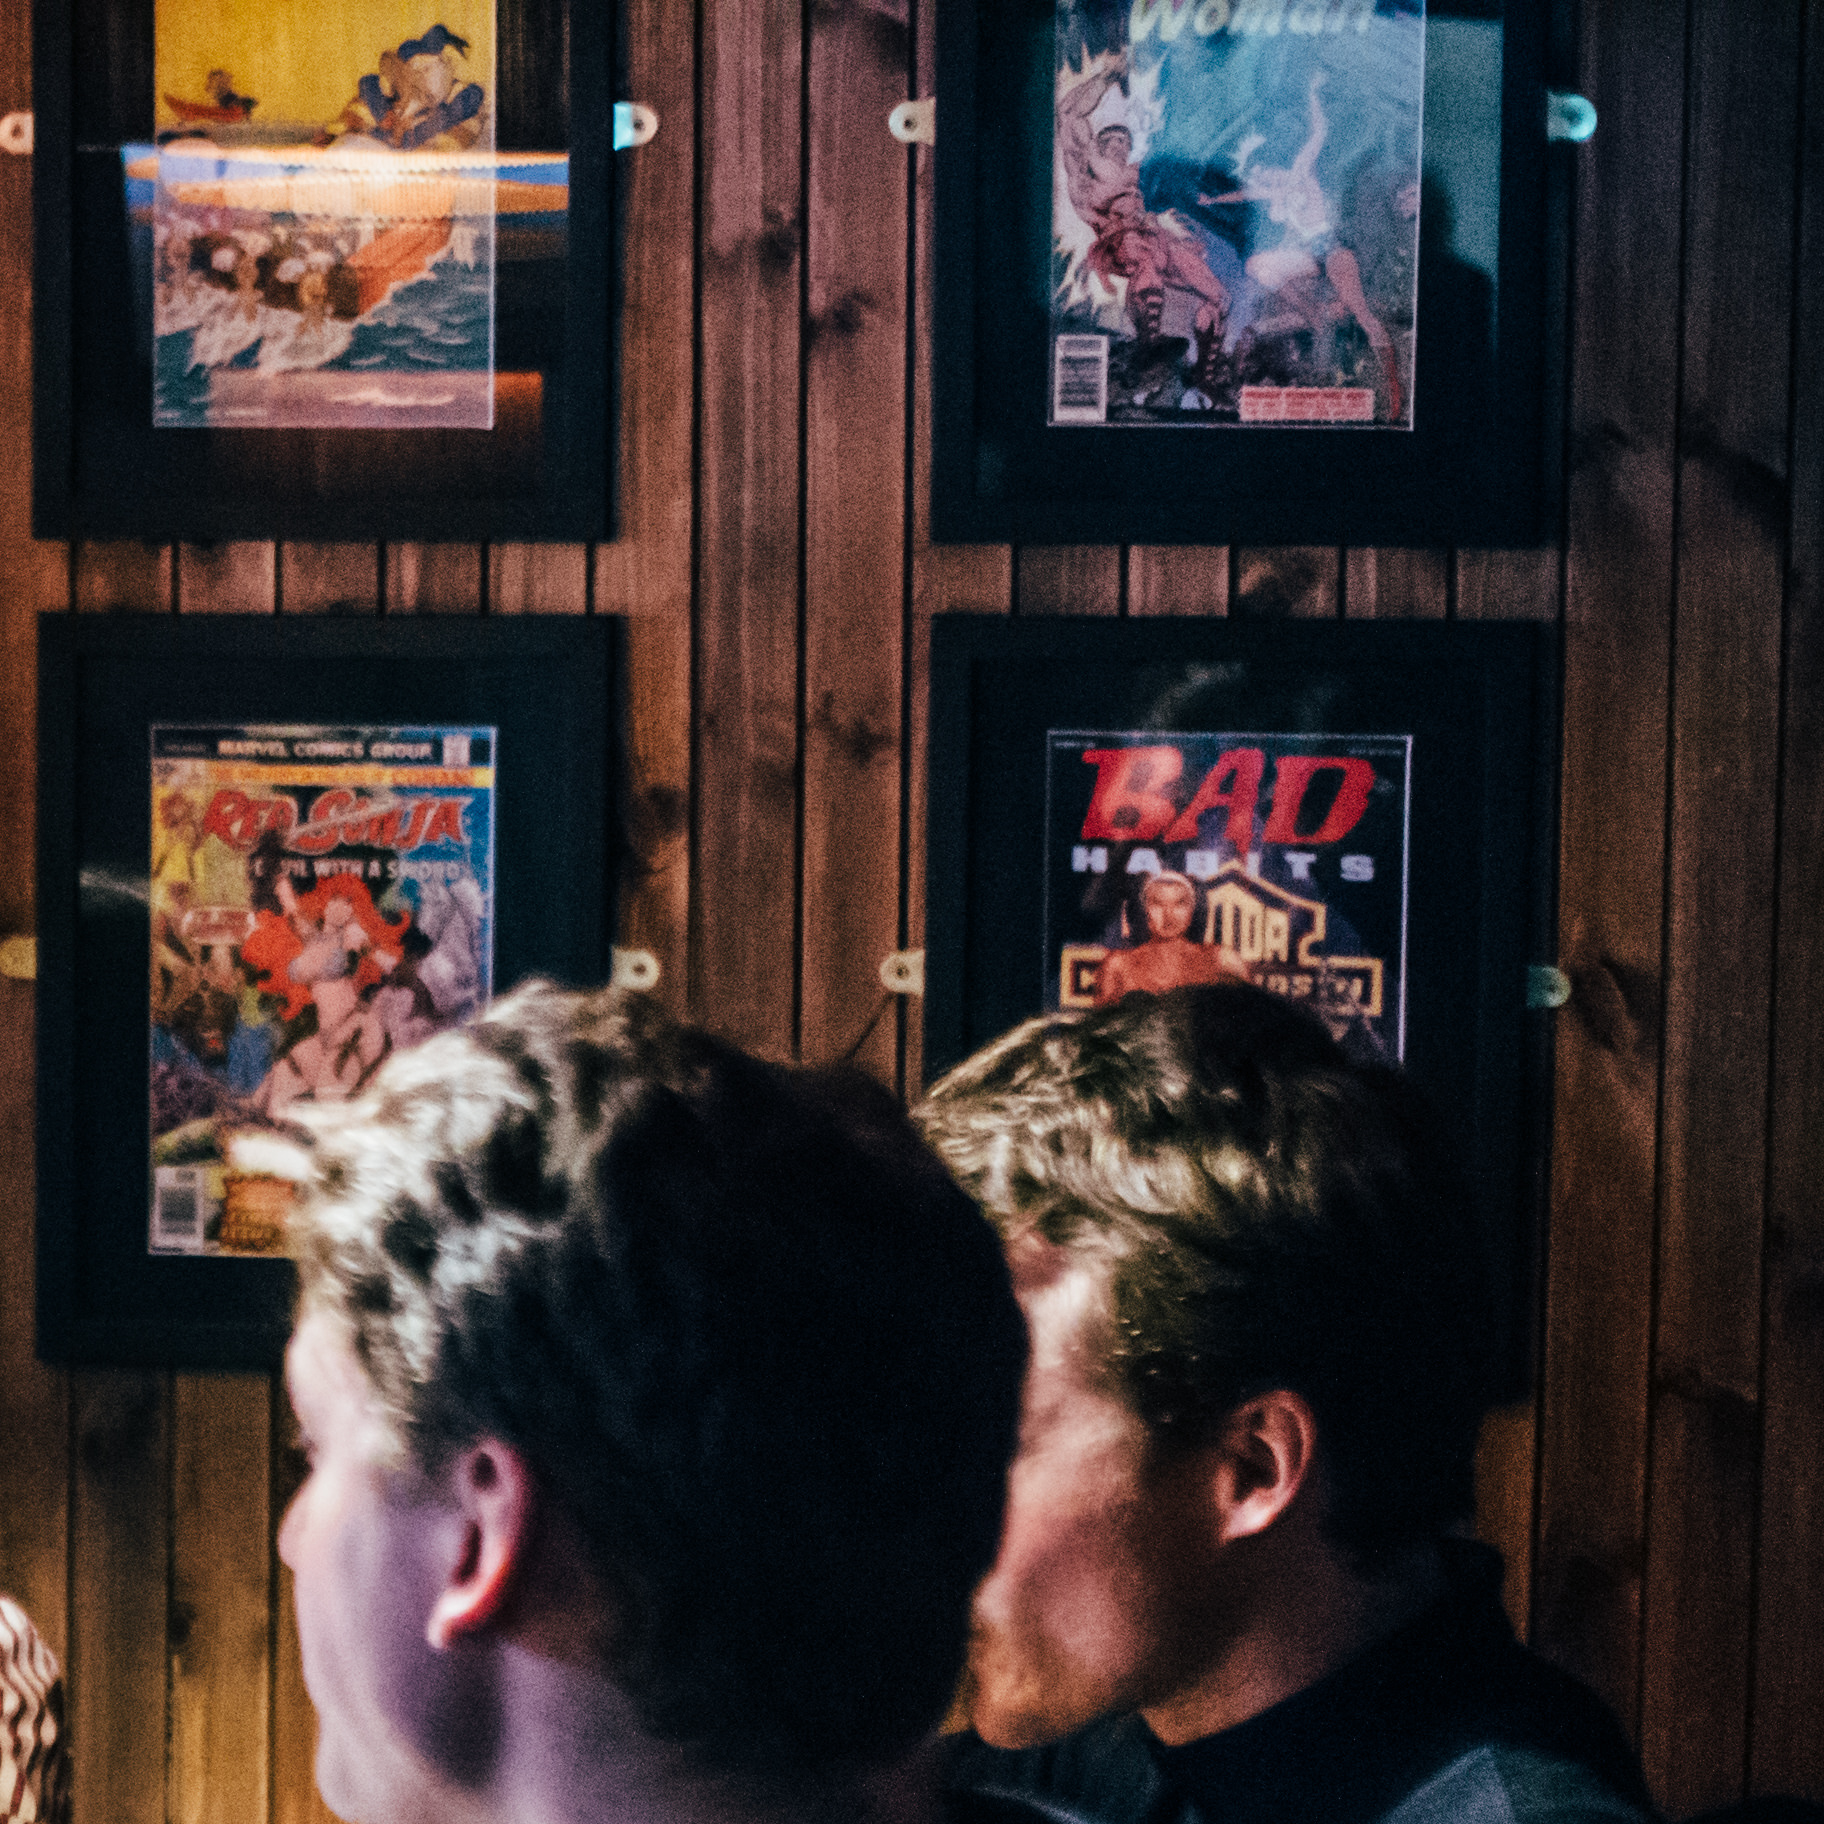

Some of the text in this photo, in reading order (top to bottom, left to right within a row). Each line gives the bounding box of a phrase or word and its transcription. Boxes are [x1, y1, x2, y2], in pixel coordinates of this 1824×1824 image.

[218, 740, 287, 757] MARVEL
[294, 742, 365, 758] COMICS
[369, 743, 433, 759] GROUP
[1082, 746, 1377, 853] BAD
[1072, 846, 1375, 882] HABITS
